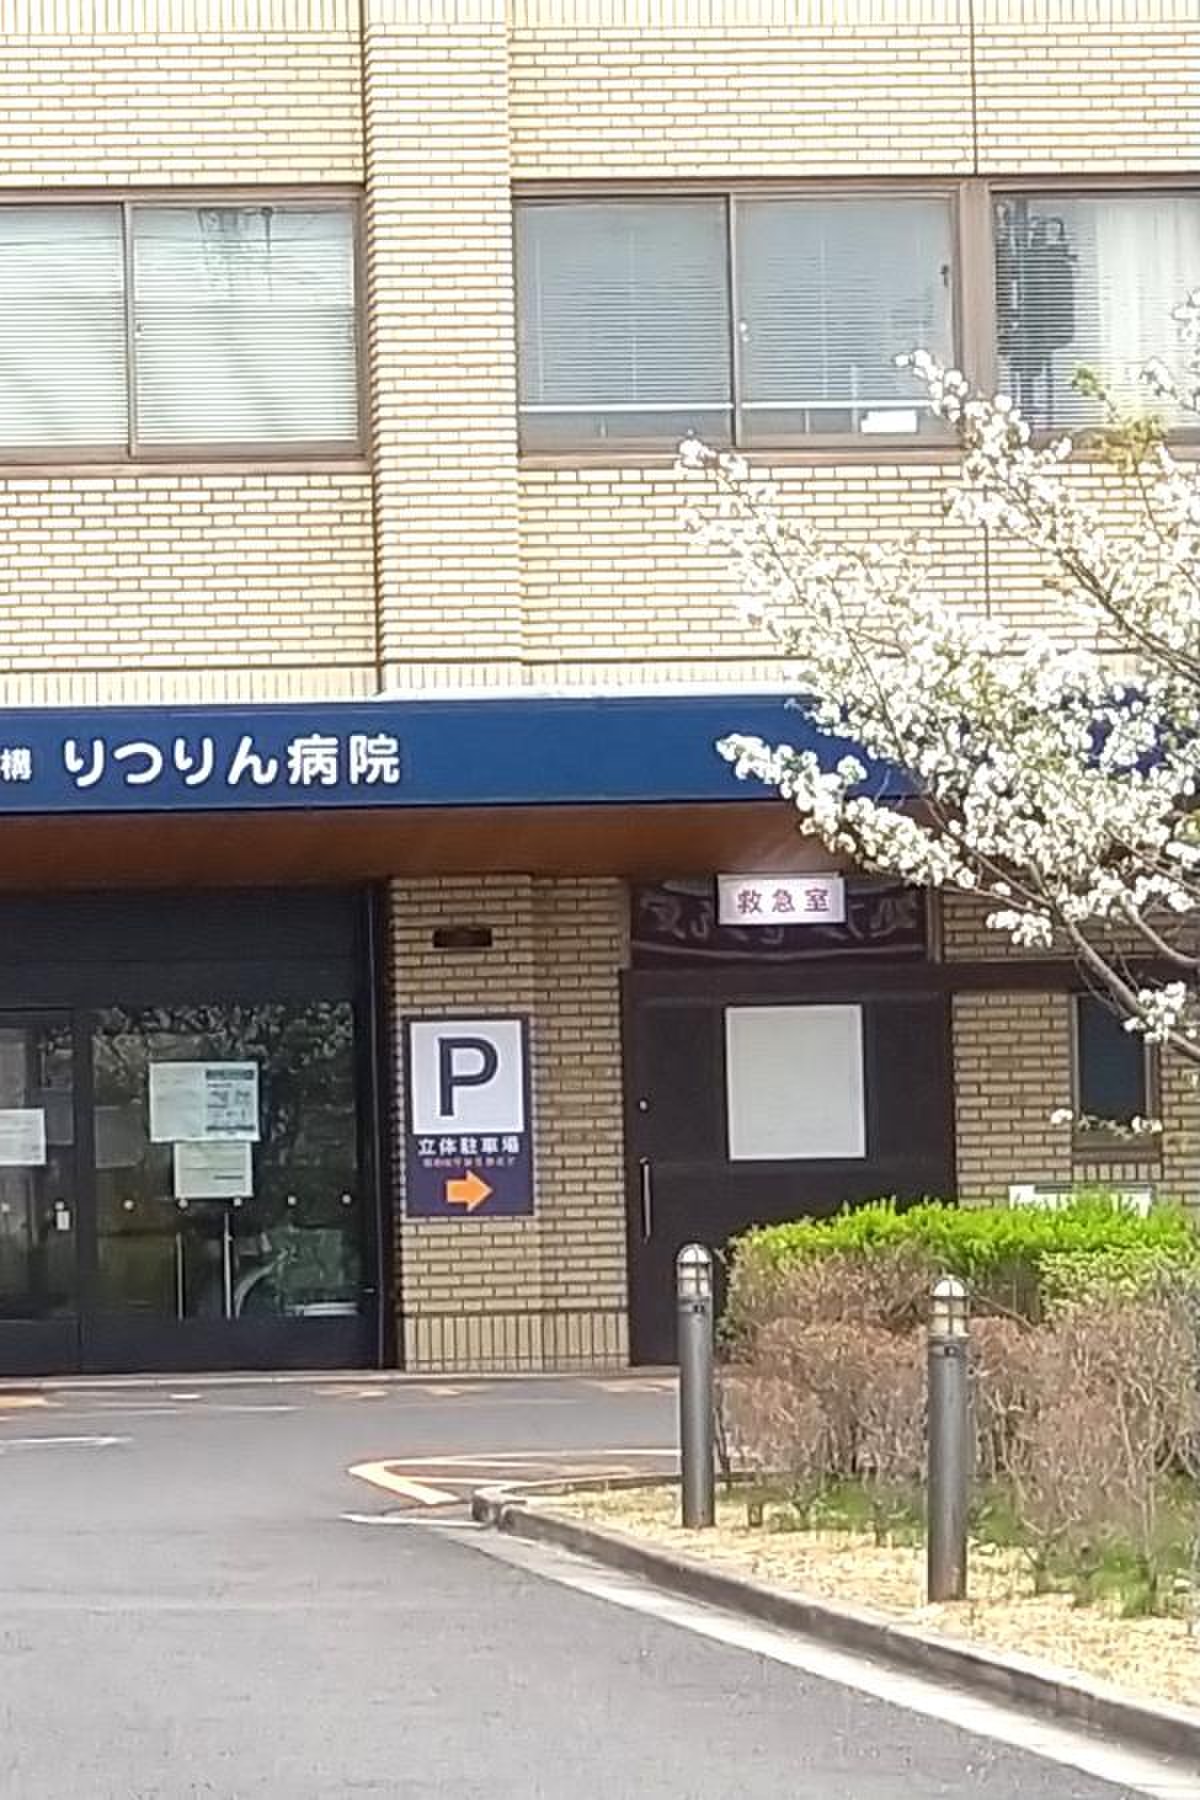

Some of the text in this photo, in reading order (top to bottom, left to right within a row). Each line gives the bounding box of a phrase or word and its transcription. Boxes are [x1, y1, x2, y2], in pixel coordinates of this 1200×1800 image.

[64, 733, 401, 787] りつりん病院
[737, 888, 830, 914] 救急室
[437, 1036, 499, 1117] P
[417, 1136, 520, 1156] 立体駐車場
